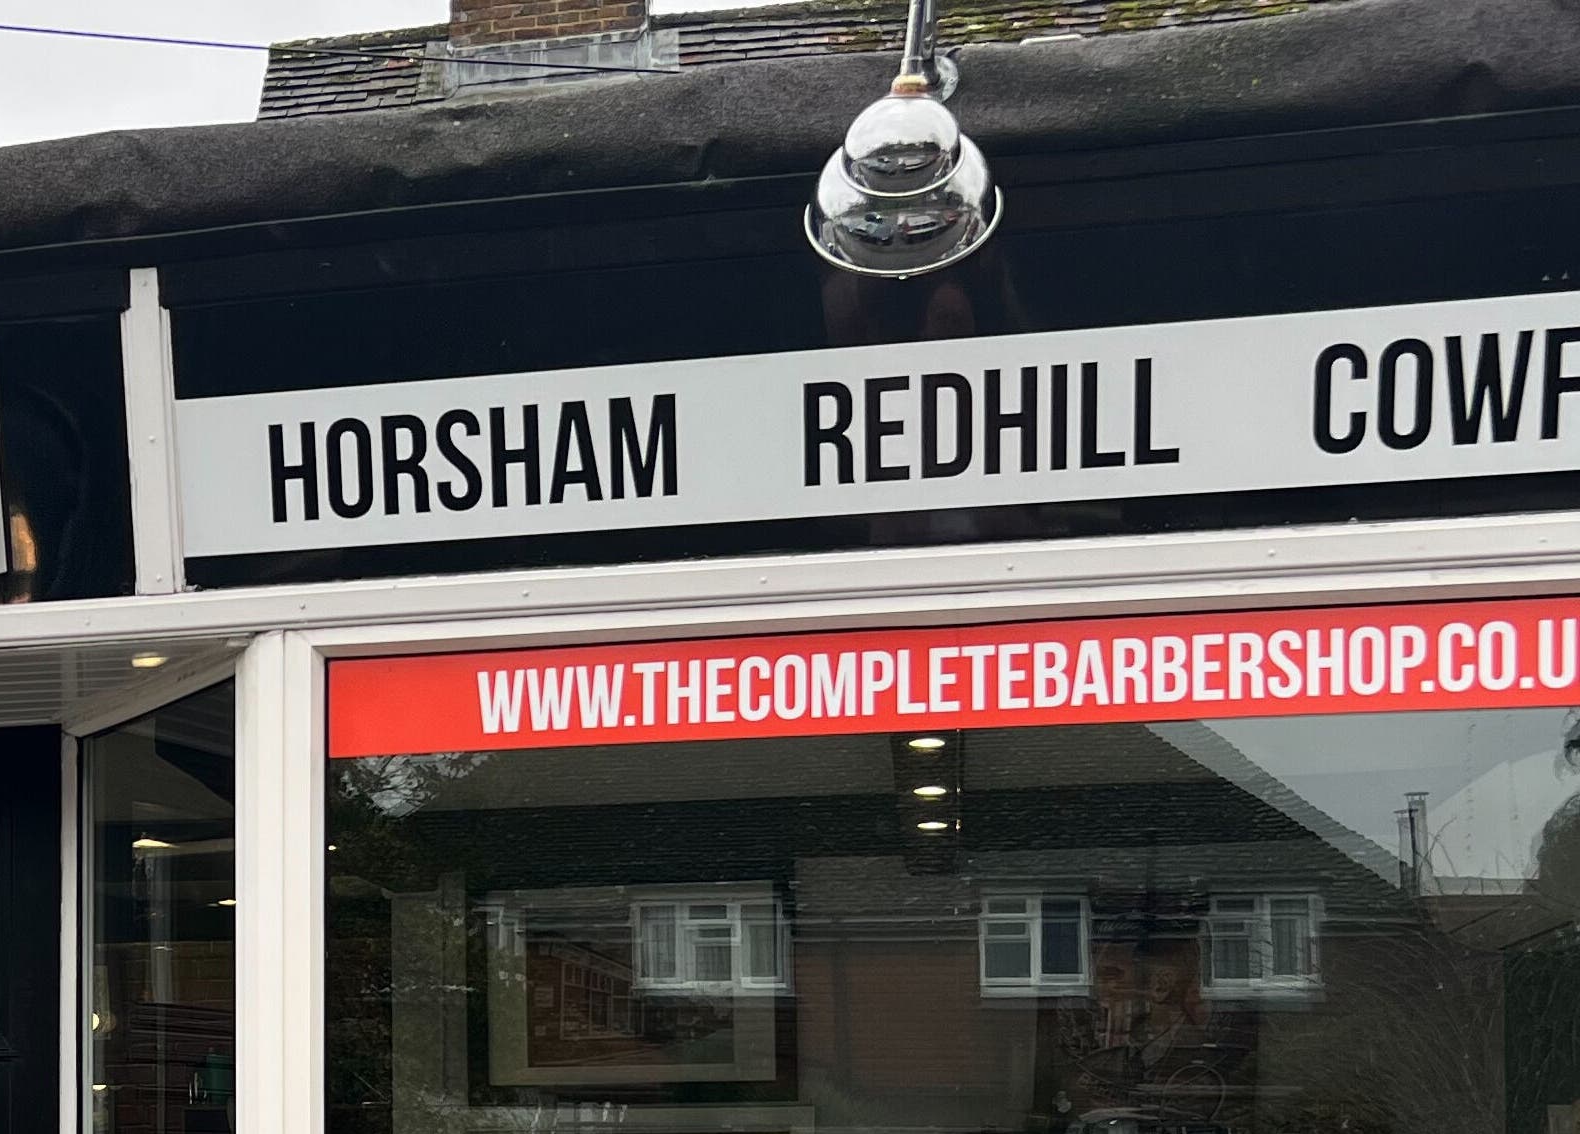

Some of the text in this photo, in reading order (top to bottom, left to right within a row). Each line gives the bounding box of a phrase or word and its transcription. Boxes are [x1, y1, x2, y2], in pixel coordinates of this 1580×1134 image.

[268, 326, 1580, 523] HORSHAM REDHILL COWF
[477, 618, 1577, 735] WWW.THECOMPLETEBARBERSHOP.CO.U
